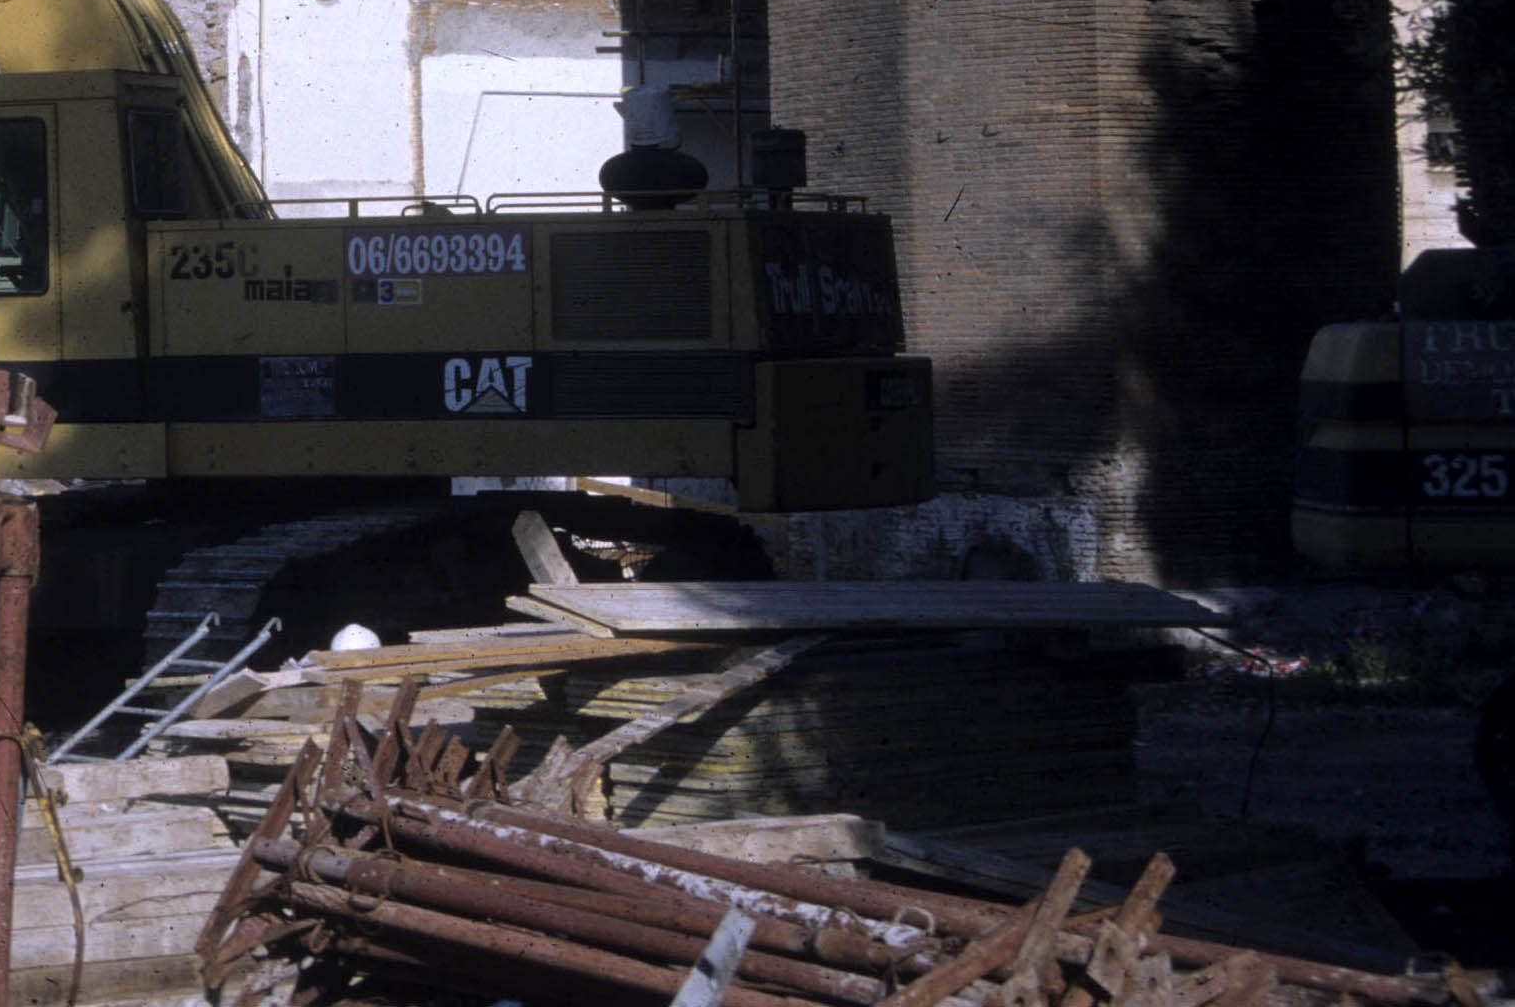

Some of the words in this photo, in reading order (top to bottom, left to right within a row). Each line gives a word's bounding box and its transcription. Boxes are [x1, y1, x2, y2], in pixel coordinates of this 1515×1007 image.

[348, 232, 526, 276] 06/6693394
[443, 357, 533, 413] CAT
[1422, 454, 1508, 497] 325
